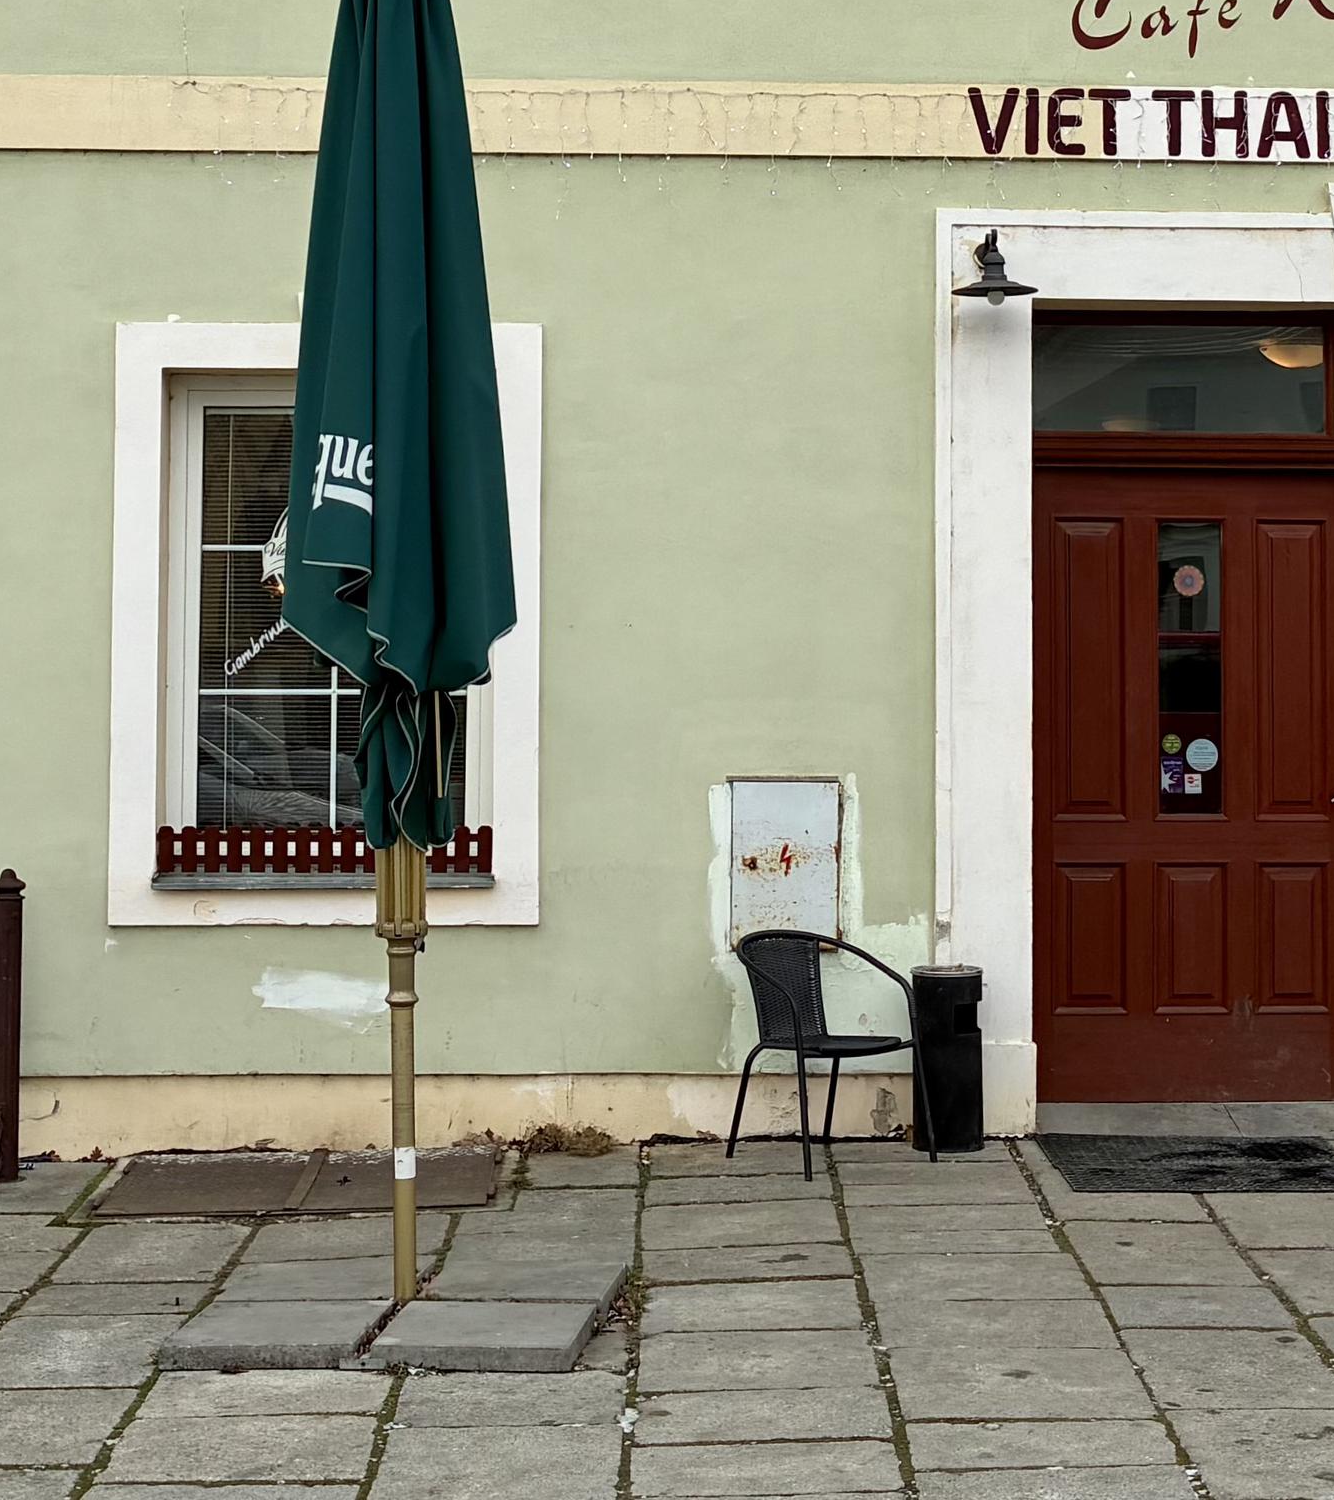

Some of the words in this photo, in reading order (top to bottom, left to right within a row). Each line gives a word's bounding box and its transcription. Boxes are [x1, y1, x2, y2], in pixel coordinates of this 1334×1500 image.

[967, 87, 1133, 156] VIET
[1152, 88, 1331, 160] THAI
[224, 615, 290, 676] Gambrinu
